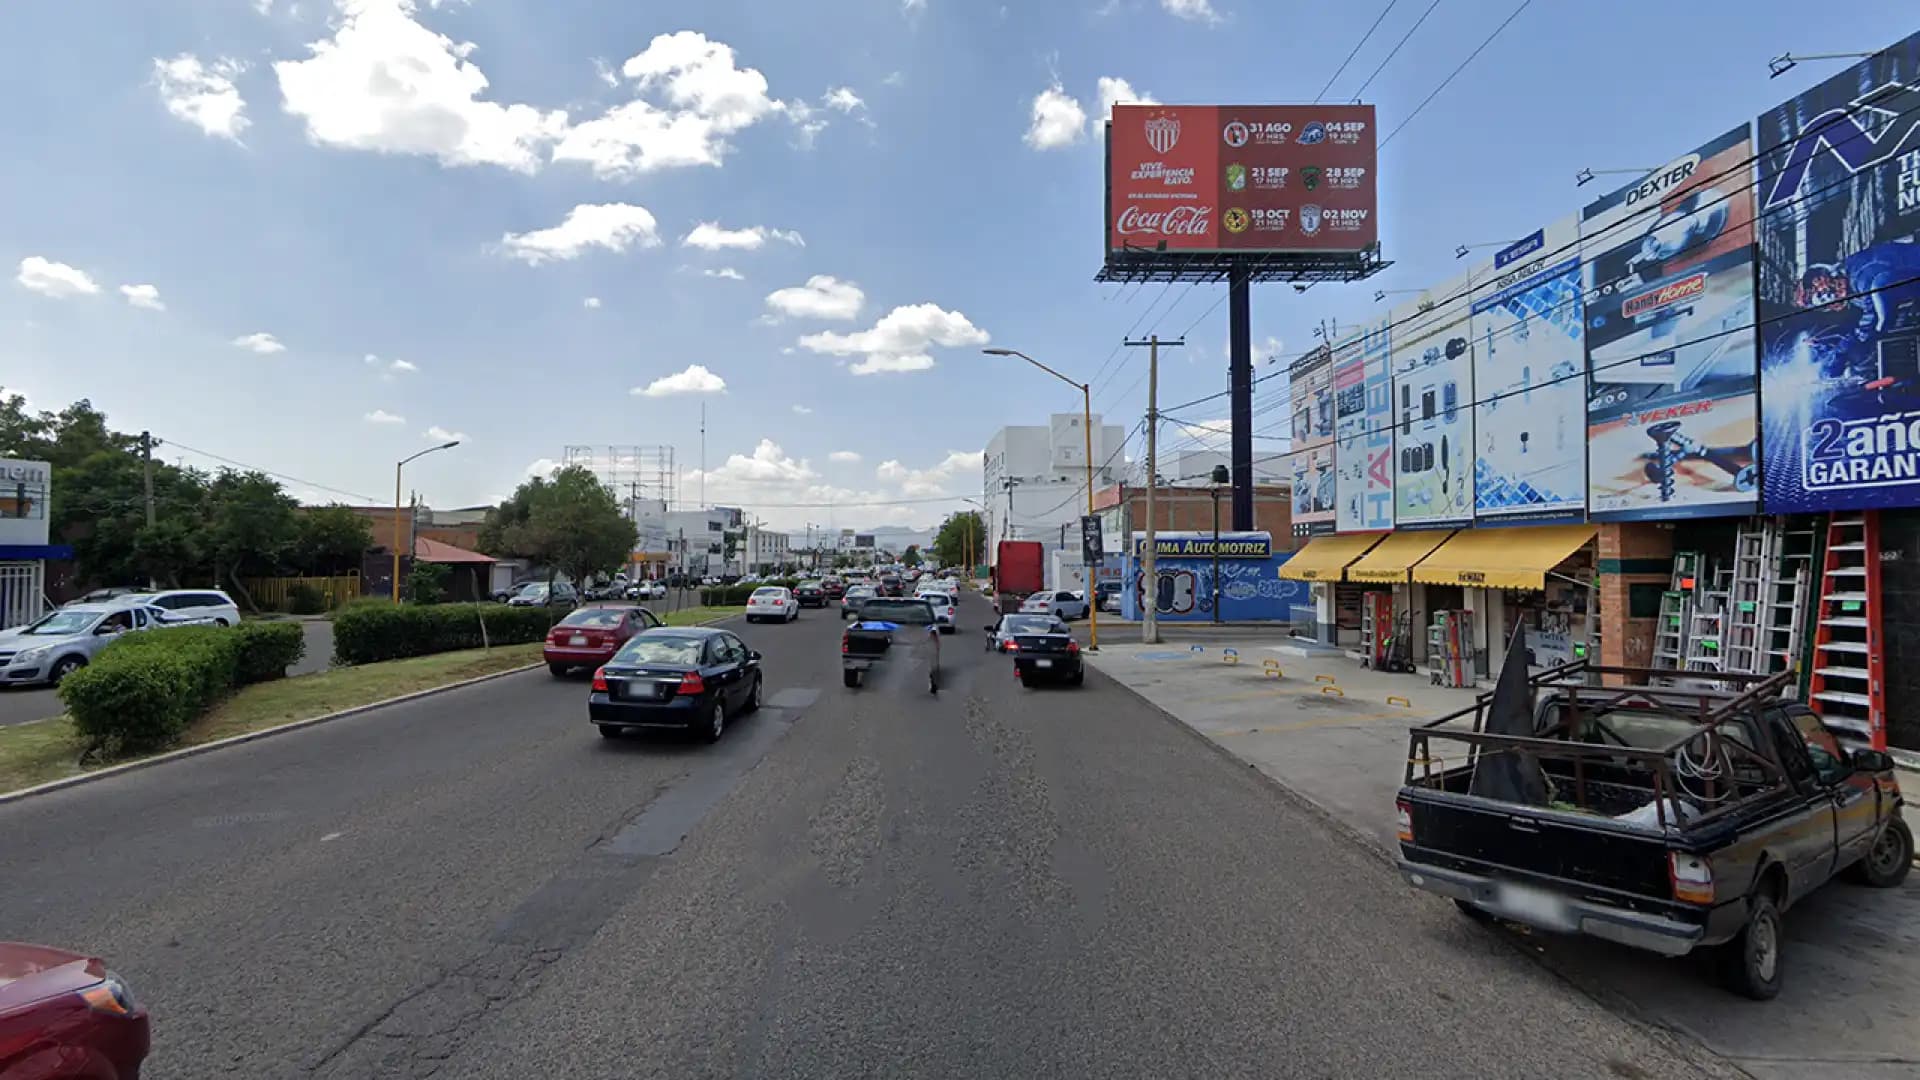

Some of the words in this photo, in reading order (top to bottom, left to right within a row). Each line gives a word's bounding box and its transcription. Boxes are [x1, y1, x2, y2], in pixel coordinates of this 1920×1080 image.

[1249, 122, 1263, 133] 31
[1265, 122, 1292, 133] AGO
[1325, 122, 1341, 133] 04
[1343, 122, 1365, 133] SEP
[1131, 167, 1195, 180] EXPERIENCIA
[1251, 167, 1265, 178] 21
[1267, 167, 1289, 178] SEP
[1325, 167, 1341, 178] 28
[1343, 167, 1365, 178] SEP
[1626, 160, 1695, 207] DEXTER
[1117, 204, 1213, 235] Coca-Cola
[1266, 209, 1291, 219] OCT
[1322, 209, 1338, 219] 02
[1340, 209, 1368, 219] NOV
[1638, 400, 1713, 425] VEKER
[1364, 319, 1392, 528] HÄFELE
[1809, 453, 1920, 485] GARAN
[1139, 540, 1180, 553] CIMA
